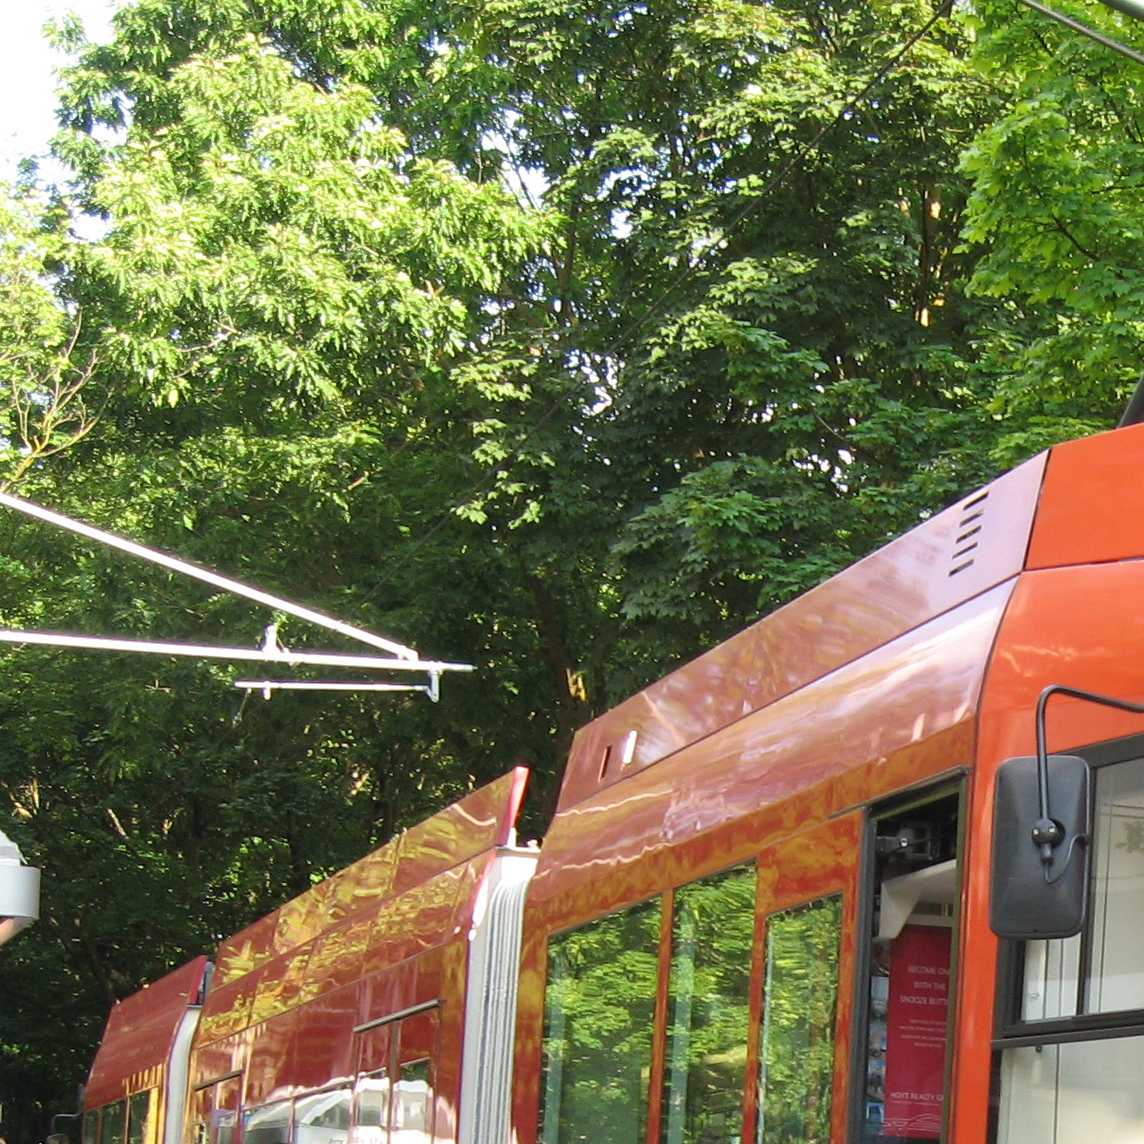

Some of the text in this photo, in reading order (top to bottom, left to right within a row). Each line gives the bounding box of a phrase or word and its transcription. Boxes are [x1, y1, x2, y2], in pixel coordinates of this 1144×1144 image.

[908, 965, 936, 975] BECOME
[913, 981, 946, 991] WITH THE
[900, 995, 927, 1005] SNOOZE
